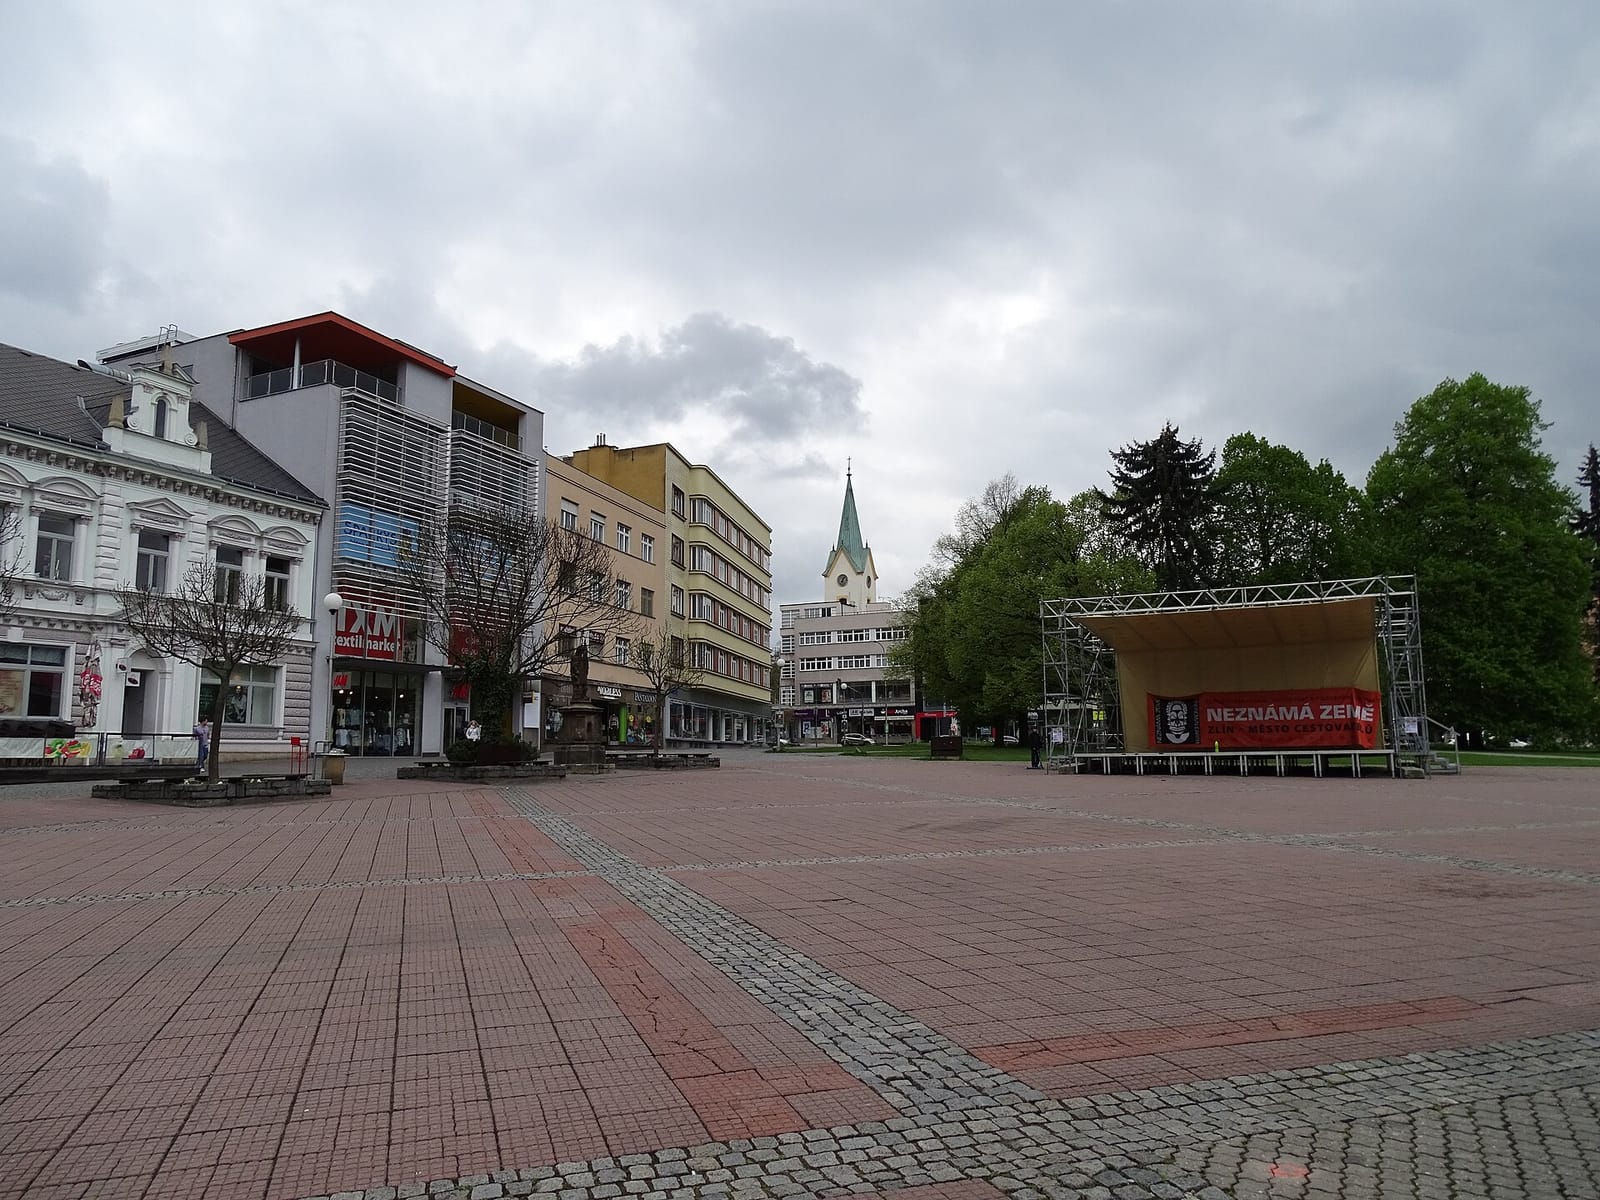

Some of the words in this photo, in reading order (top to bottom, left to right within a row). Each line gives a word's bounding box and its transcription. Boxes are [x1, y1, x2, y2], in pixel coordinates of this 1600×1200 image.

[343, 521, 398, 545] SPAKYS
[1206, 703, 1315, 722] NEZNÁMÁ
[1319, 703, 1375, 722] ZEMĚ
[1208, 725, 1234, 735] ZLÍN
[1248, 722, 1290, 735] MĚSTO
